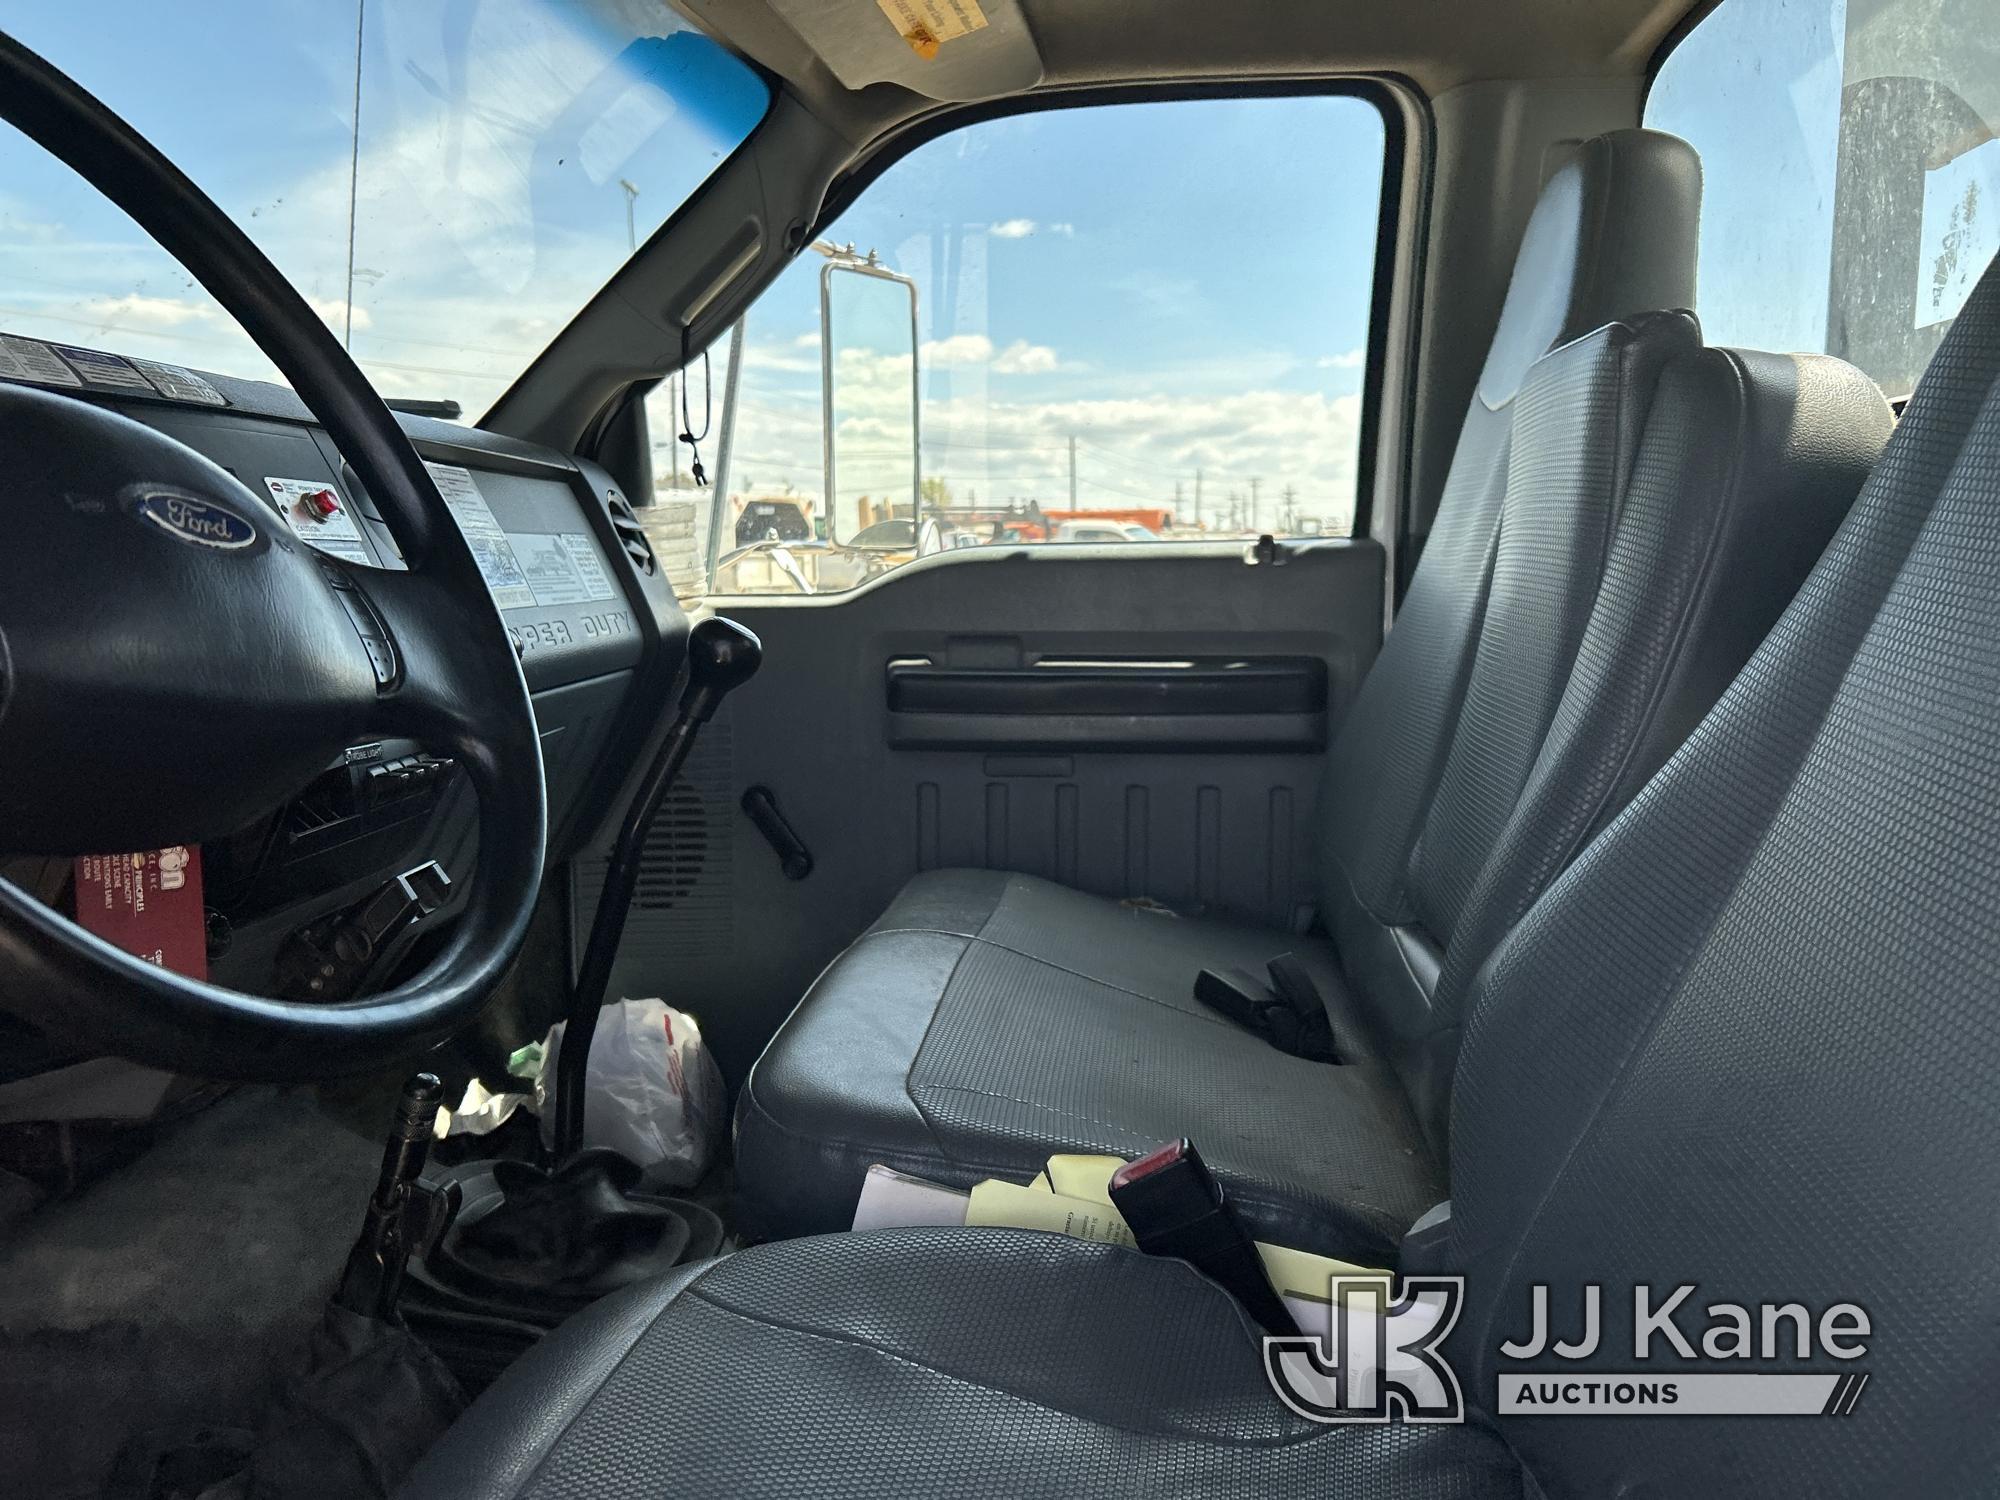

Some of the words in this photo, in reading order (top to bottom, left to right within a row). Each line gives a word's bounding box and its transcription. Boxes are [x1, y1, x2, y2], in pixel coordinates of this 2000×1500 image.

[167, 499, 233, 539] Ford
[580, 610, 632, 638] DUTY
[123, 872, 132, 904] CAPACITY
[135, 870, 144, 911] PRINCIPLES
